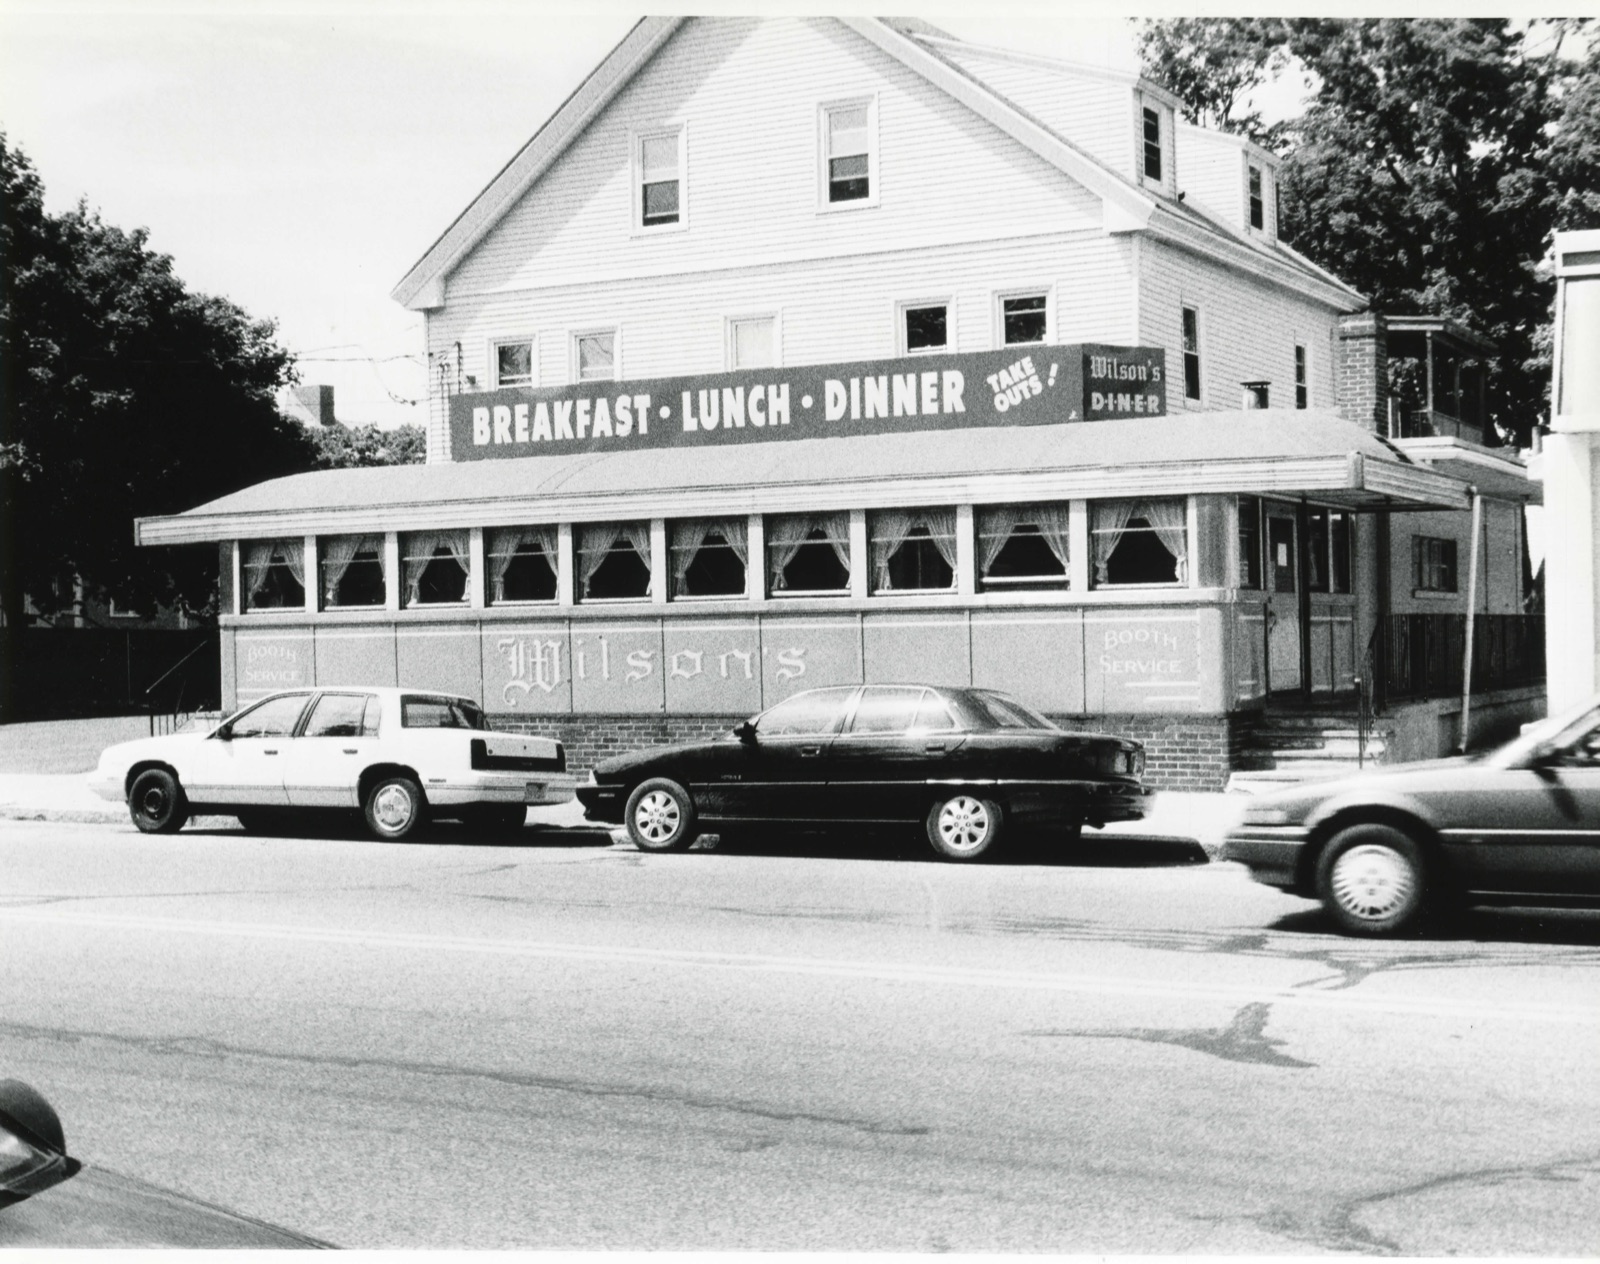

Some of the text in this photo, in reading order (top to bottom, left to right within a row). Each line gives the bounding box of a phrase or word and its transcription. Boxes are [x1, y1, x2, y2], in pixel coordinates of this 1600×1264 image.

[986, 356, 1036, 394] TAKE
[1090, 355, 1161, 382] Wilson's
[472, 370, 966, 446] BREAKFAST LUNCH DINNER
[247, 645, 297, 664] BOOTH
[1104, 629, 1178, 651] BOOTH
[498, 638, 808, 706] Wilson's
